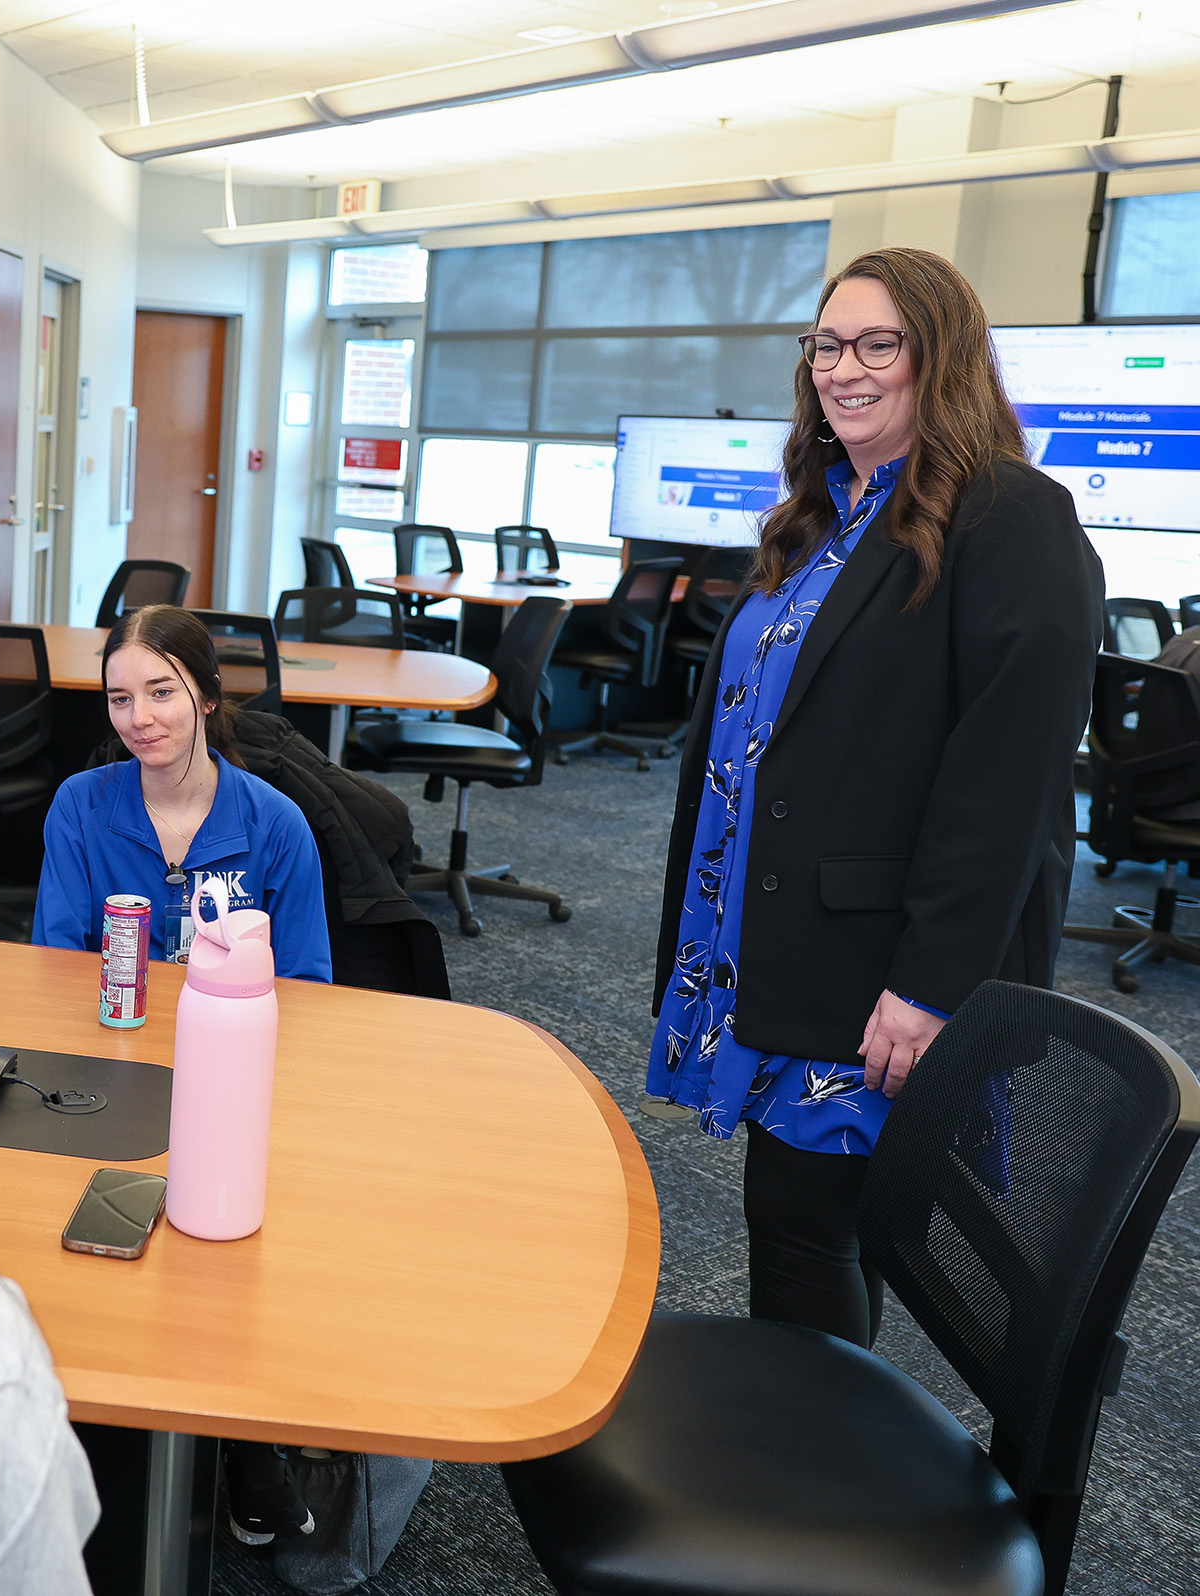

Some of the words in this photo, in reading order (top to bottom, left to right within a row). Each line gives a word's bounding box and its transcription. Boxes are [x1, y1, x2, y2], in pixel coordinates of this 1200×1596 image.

[1096, 440, 1141, 456] Module
[1142, 440, 1154, 456] 7
[210, 898, 254, 907] PGRAM
